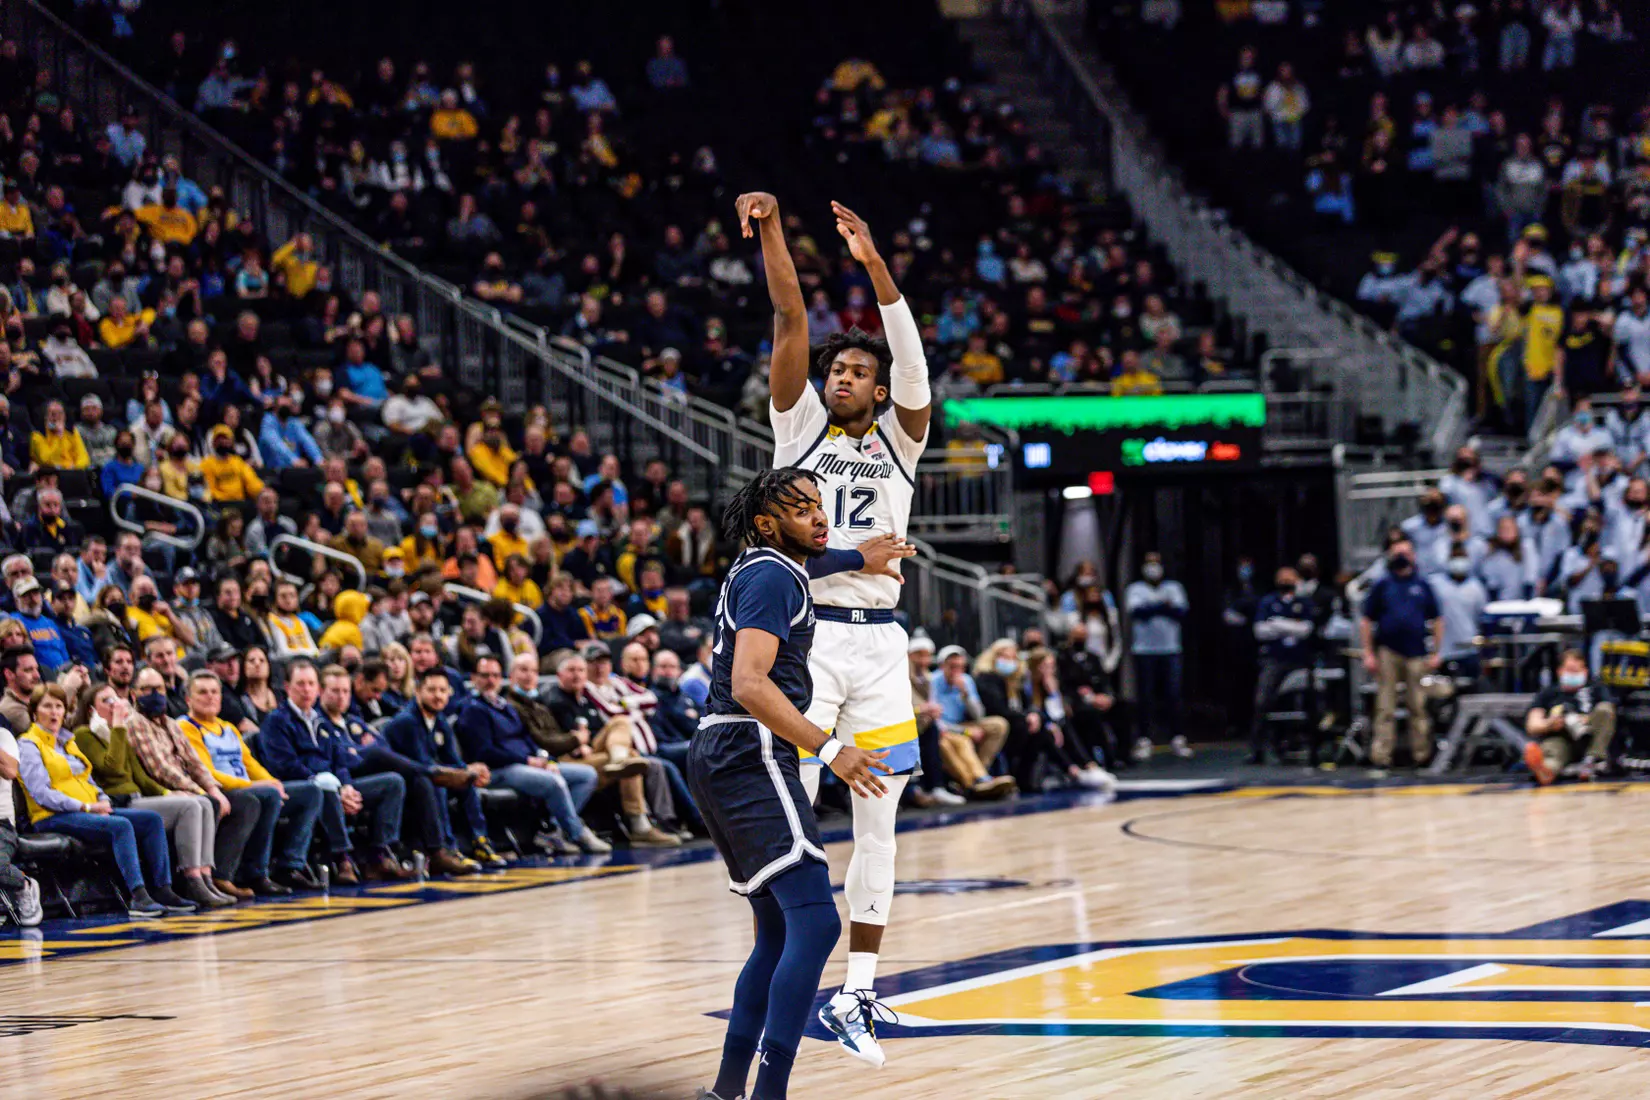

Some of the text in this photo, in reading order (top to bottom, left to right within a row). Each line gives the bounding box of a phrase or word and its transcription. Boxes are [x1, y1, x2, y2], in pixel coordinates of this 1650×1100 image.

[813, 453, 895, 482] Marquette
[834, 485, 877, 529] 12
[851, 609, 867, 622] AL
